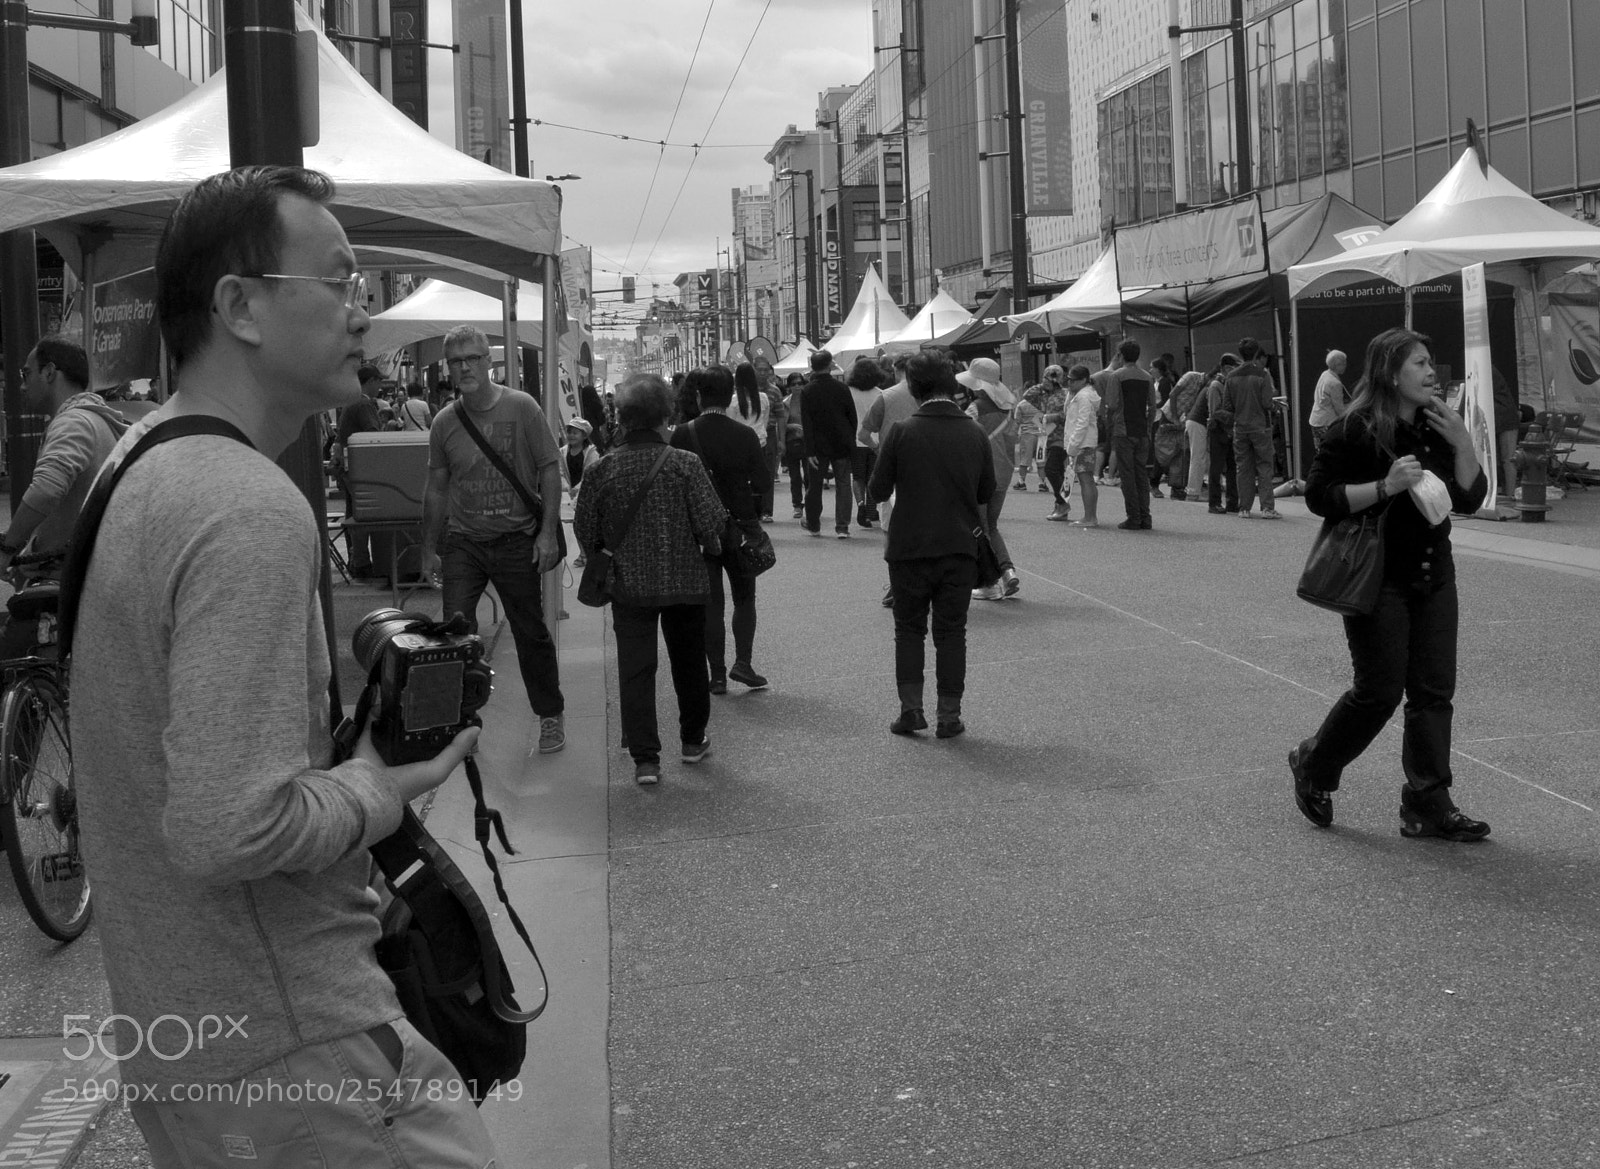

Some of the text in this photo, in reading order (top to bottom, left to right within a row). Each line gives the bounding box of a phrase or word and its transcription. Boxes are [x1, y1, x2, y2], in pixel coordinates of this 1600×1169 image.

[1029, 100, 1049, 205] GRANVILLE
[827, 241, 838, 270] OLD
[1184, 240, 1219, 264] concerts
[828, 273, 839, 314] NAVY
[1323, 289, 1332, 298] to
[1334, 287, 1346, 297] be
[1348, 289, 1353, 298] a
[1356, 286, 1374, 300] part
[1376, 284, 1385, 295] of
[1388, 283, 1401, 294] the
[1404, 283, 1452, 294] mmunity
[94, 298, 157, 325] onservative Party
[97, 327, 121, 353] Canada
